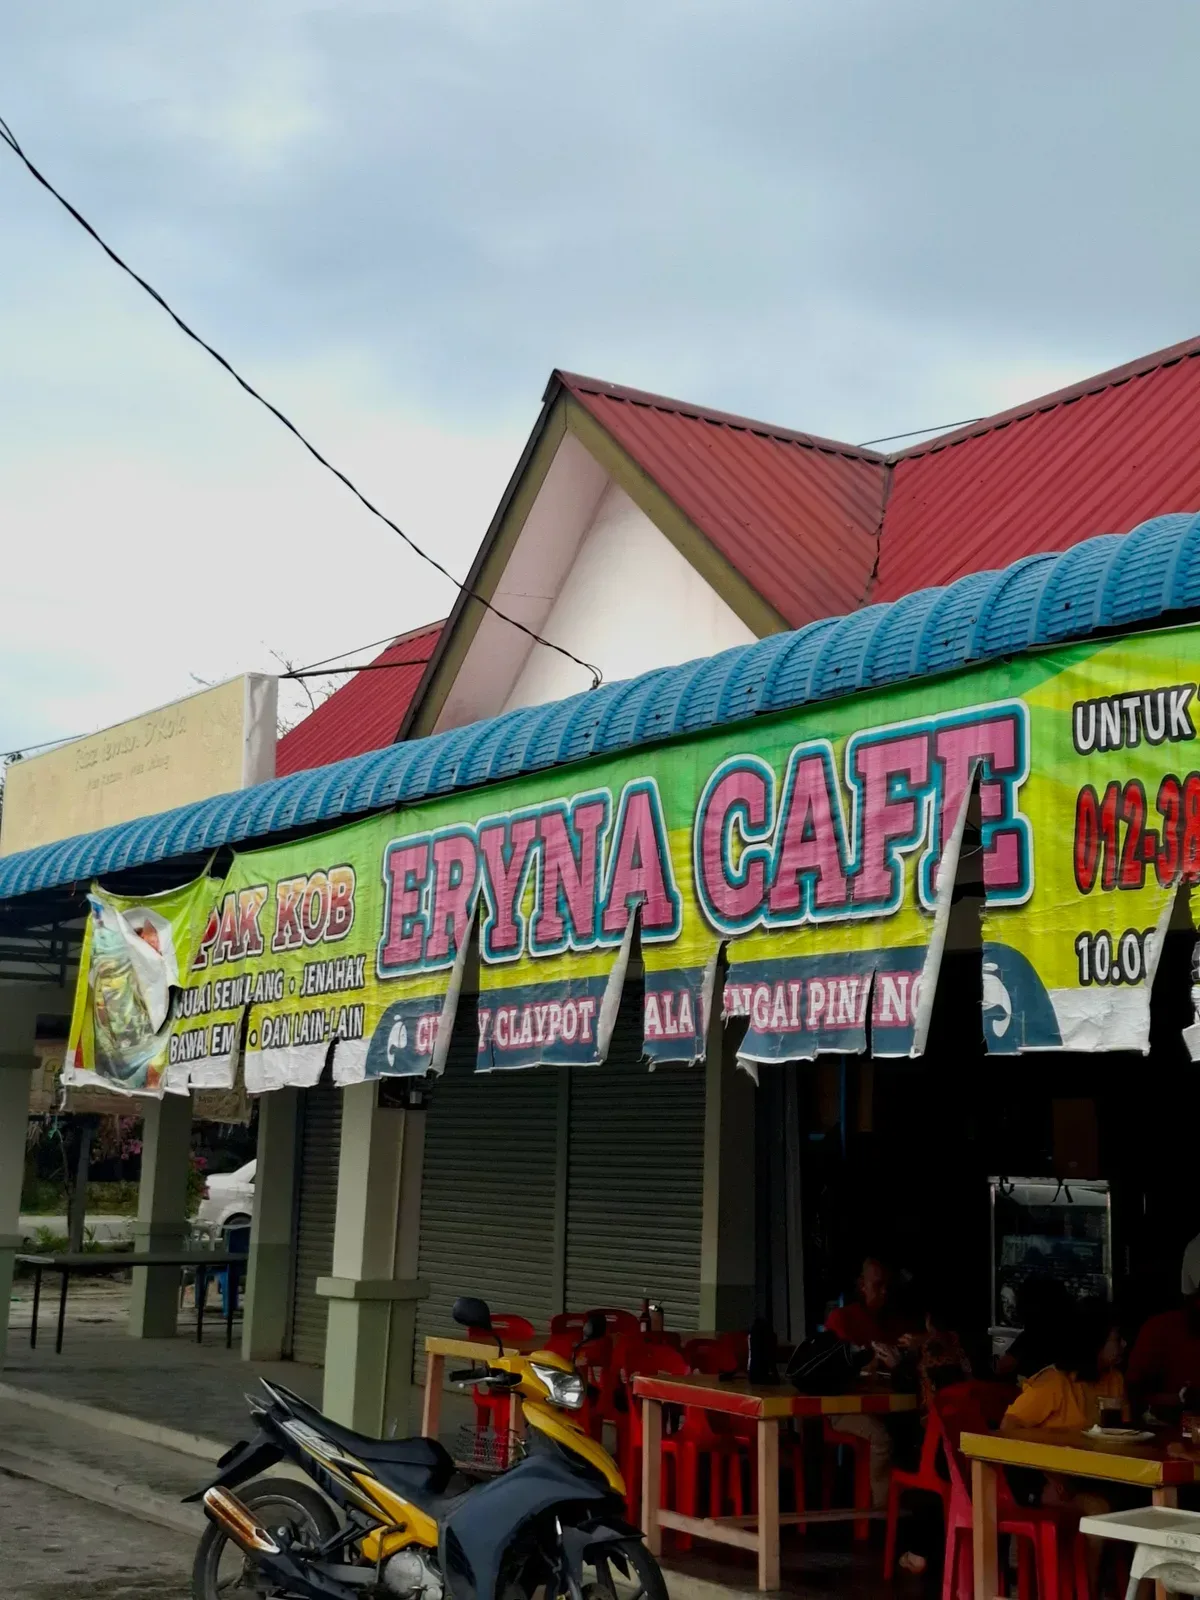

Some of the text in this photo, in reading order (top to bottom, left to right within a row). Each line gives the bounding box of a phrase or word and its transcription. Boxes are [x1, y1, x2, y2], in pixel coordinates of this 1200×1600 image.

[1074, 684, 1196, 754] UNTUK
[378, 702, 1032, 978] ERYNA CAFE
[272, 864, 357, 954] KOB
[300, 954, 367, 998] JENAHAK
[261, 1016, 290, 1050] DAN
[293, 1003, 364, 1047] LAIN-LAIN
[495, 998, 595, 1048] CLAYPOT
[643, 990, 695, 1038] ALA
